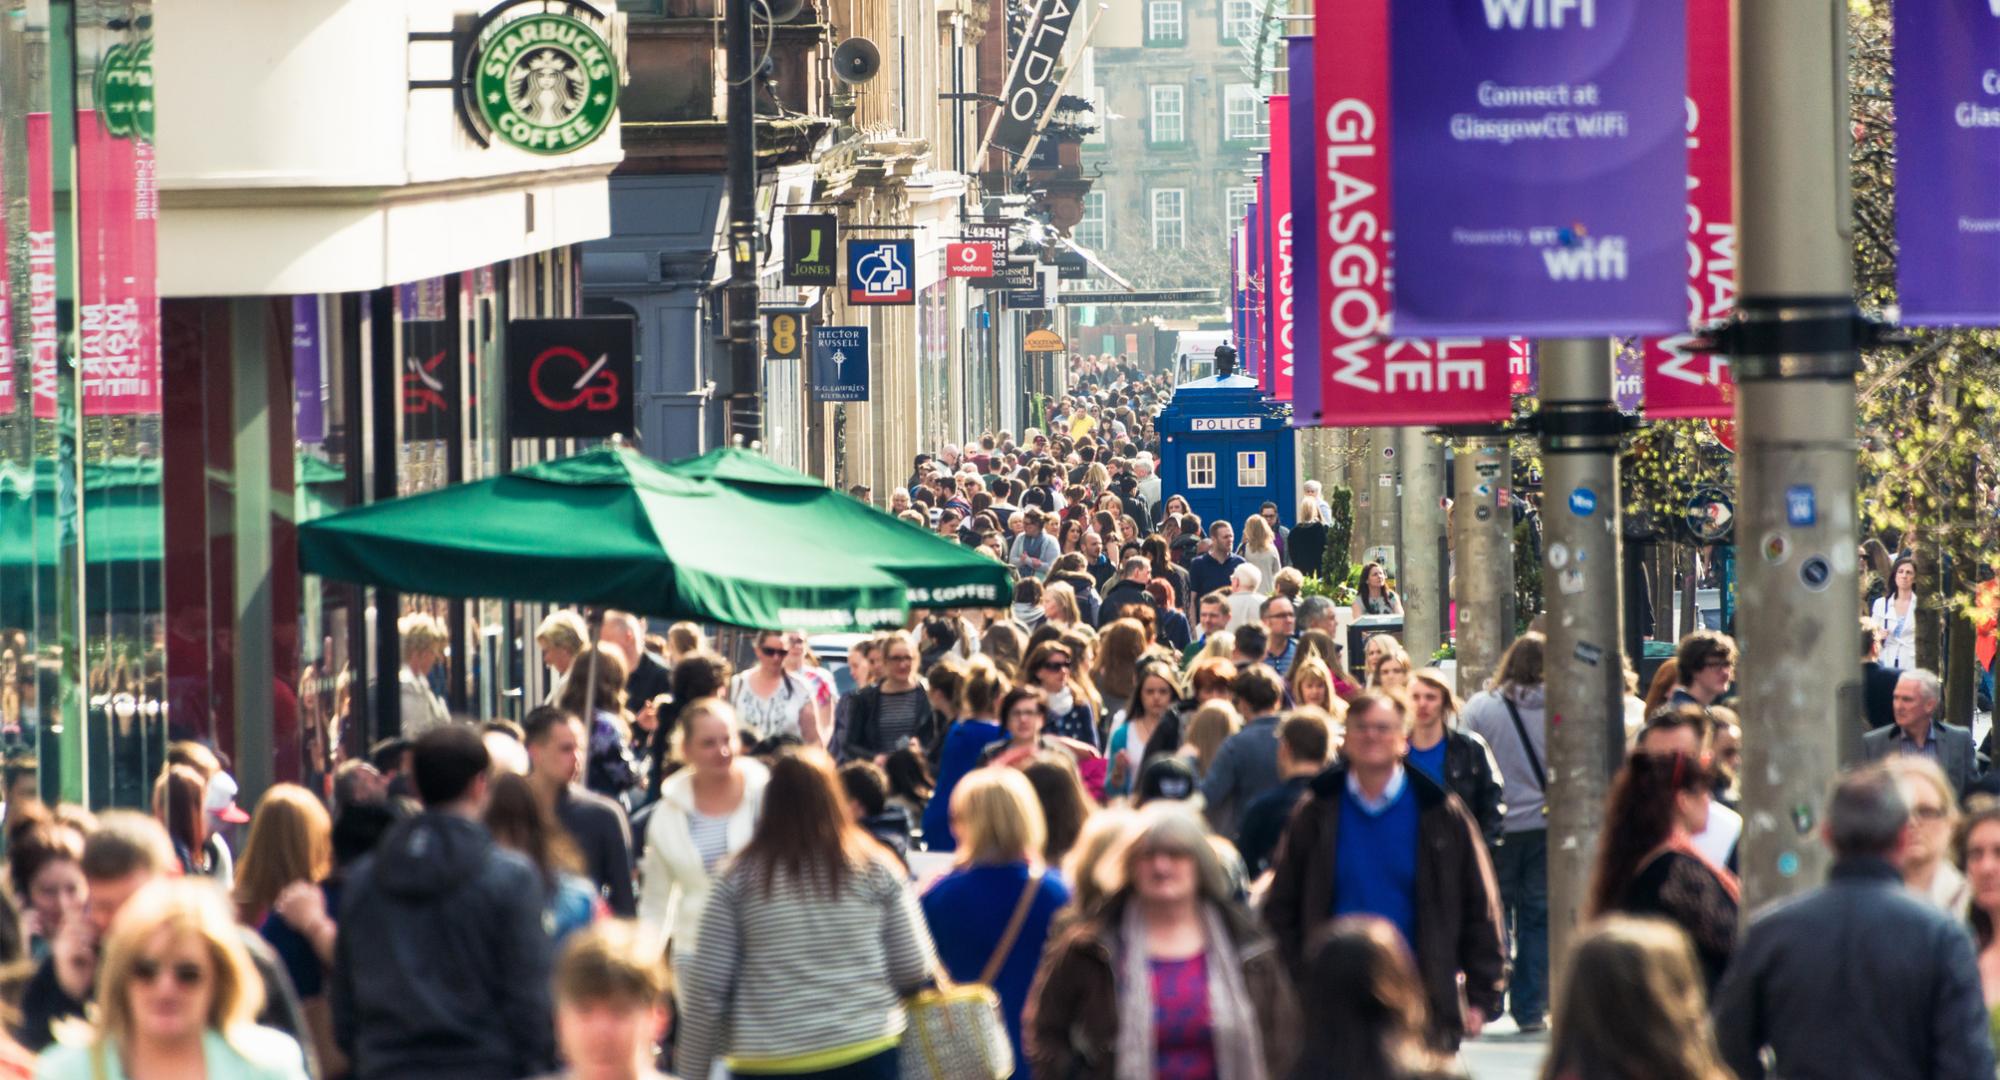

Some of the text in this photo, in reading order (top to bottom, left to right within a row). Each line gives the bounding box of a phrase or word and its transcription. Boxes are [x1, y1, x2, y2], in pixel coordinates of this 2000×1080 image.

[485, 22, 610, 80] STARBUCKS
[1011, 0, 1071, 122] ALDO
[1478, 80, 1599, 107] Connect at
[498, 112, 594, 149] COFFEE
[964, 227, 1006, 239] LUSH
[1326, 97, 1381, 393] GLASGOW
[1542, 235, 1628, 281] wifi
[791, 263, 831, 277] JONES
[952, 264, 987, 273] vodafone
[818, 330, 859, 339] HECTOR
[818, 339, 860, 347] RUSSELL
[1196, 418, 1255, 430] POLICE
